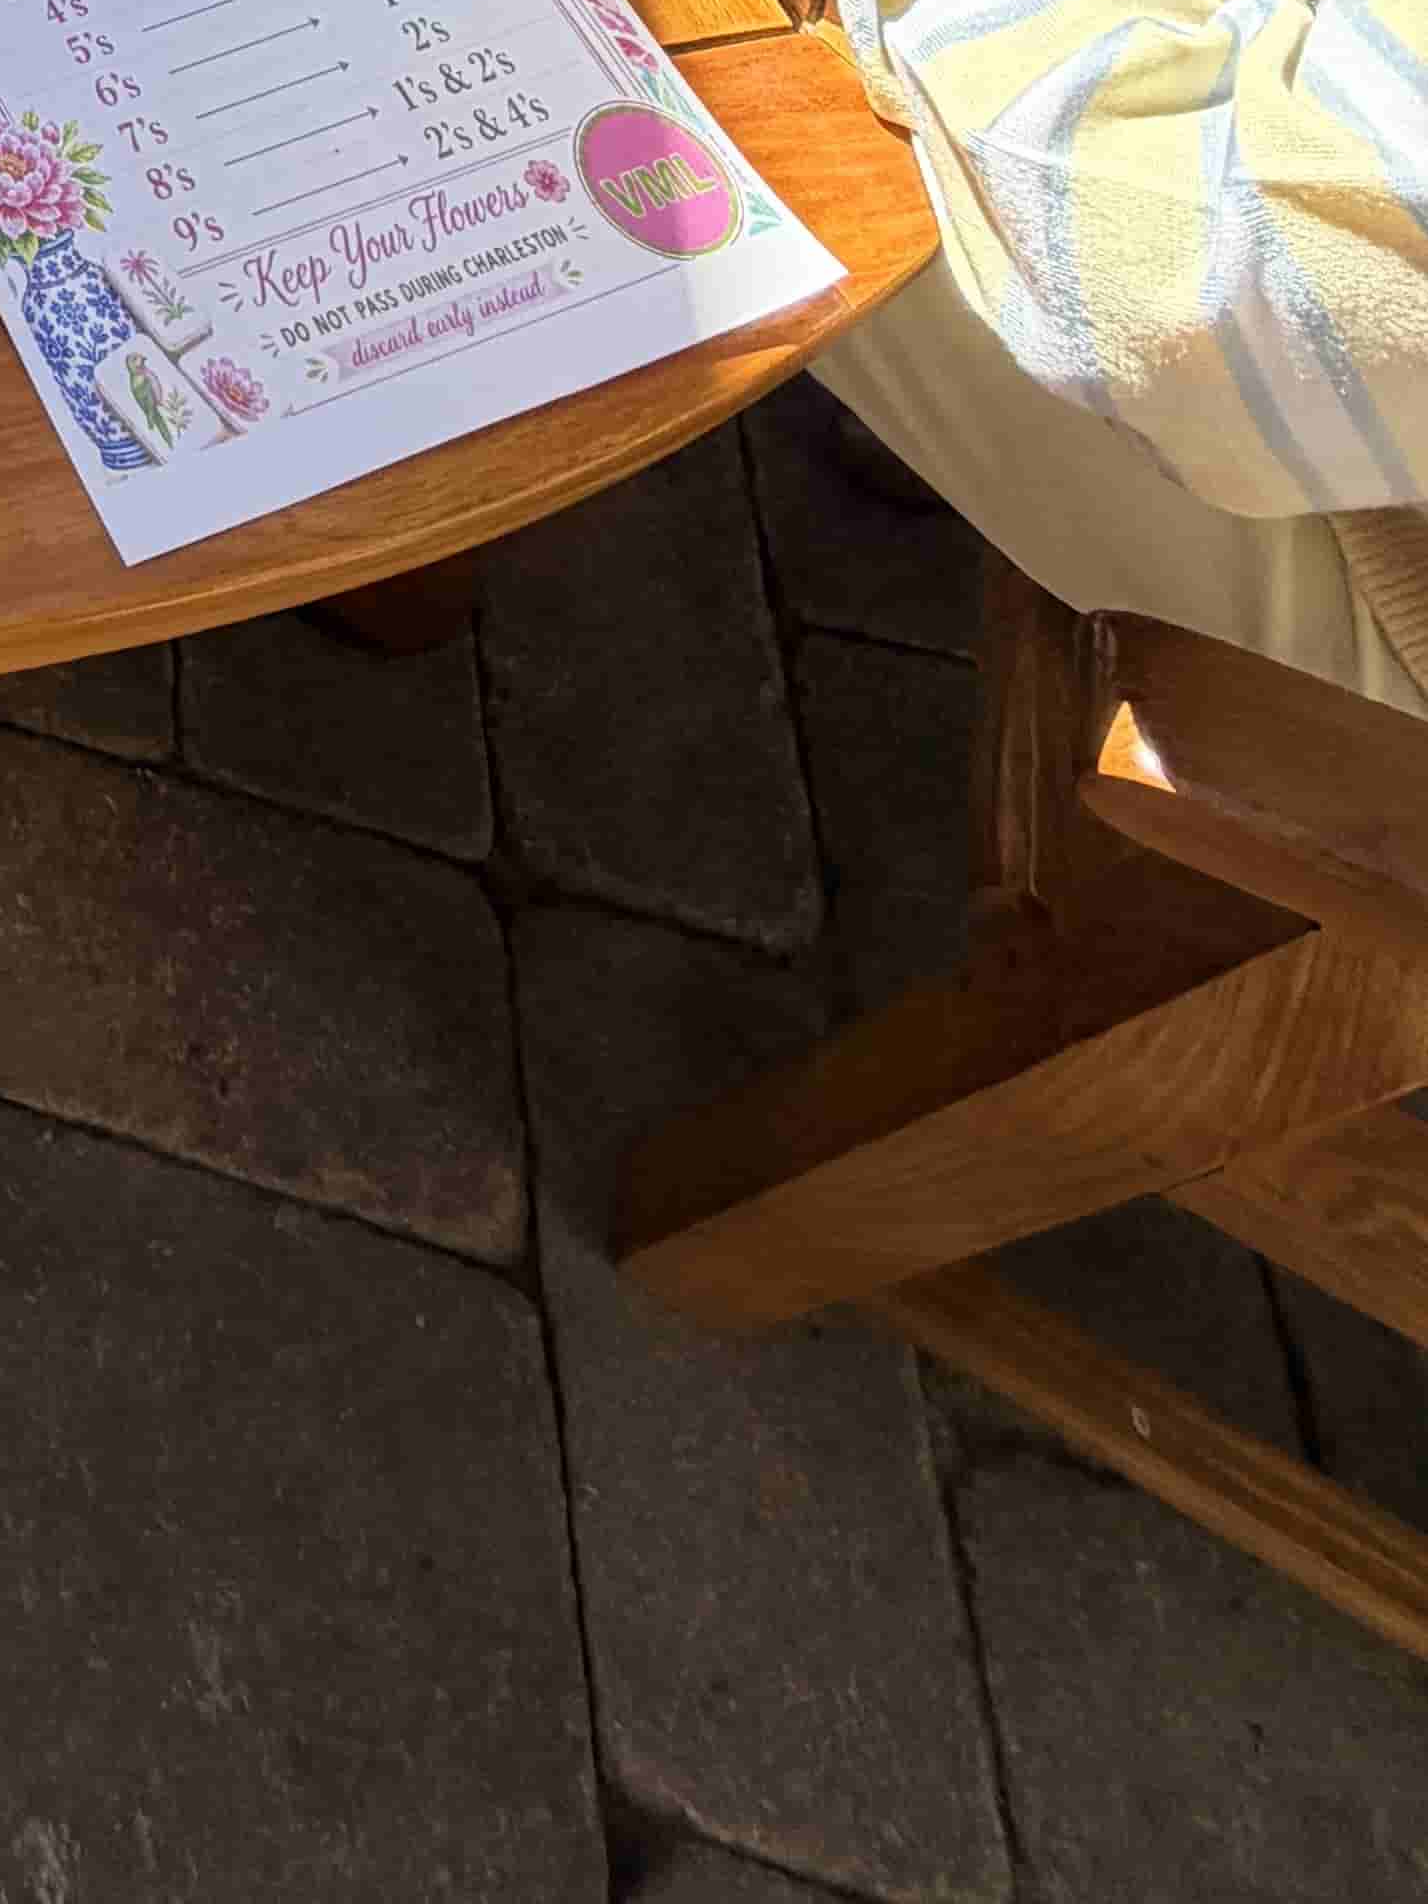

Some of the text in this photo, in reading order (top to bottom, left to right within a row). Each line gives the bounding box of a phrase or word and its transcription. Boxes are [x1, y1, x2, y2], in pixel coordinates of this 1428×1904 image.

[66, 33, 115, 64] 5's
[402, 17, 451, 51] 2's
[96, 73, 142, 106] 6's
[392, 48, 516, 112] 1's & 2's
[118, 117, 169, 153] 7's
[423, 93, 550, 159] 2's & 4's
[146, 164, 196, 199] 8's
[600, 153, 716, 218] VML
[174, 213, 225, 251] 9's
[243, 182, 530, 308] Keep Your Flowers
[281, 224, 569, 348] DO NOT PASS DURING CHARLESTON
[351, 273, 545, 369] discard early instead
